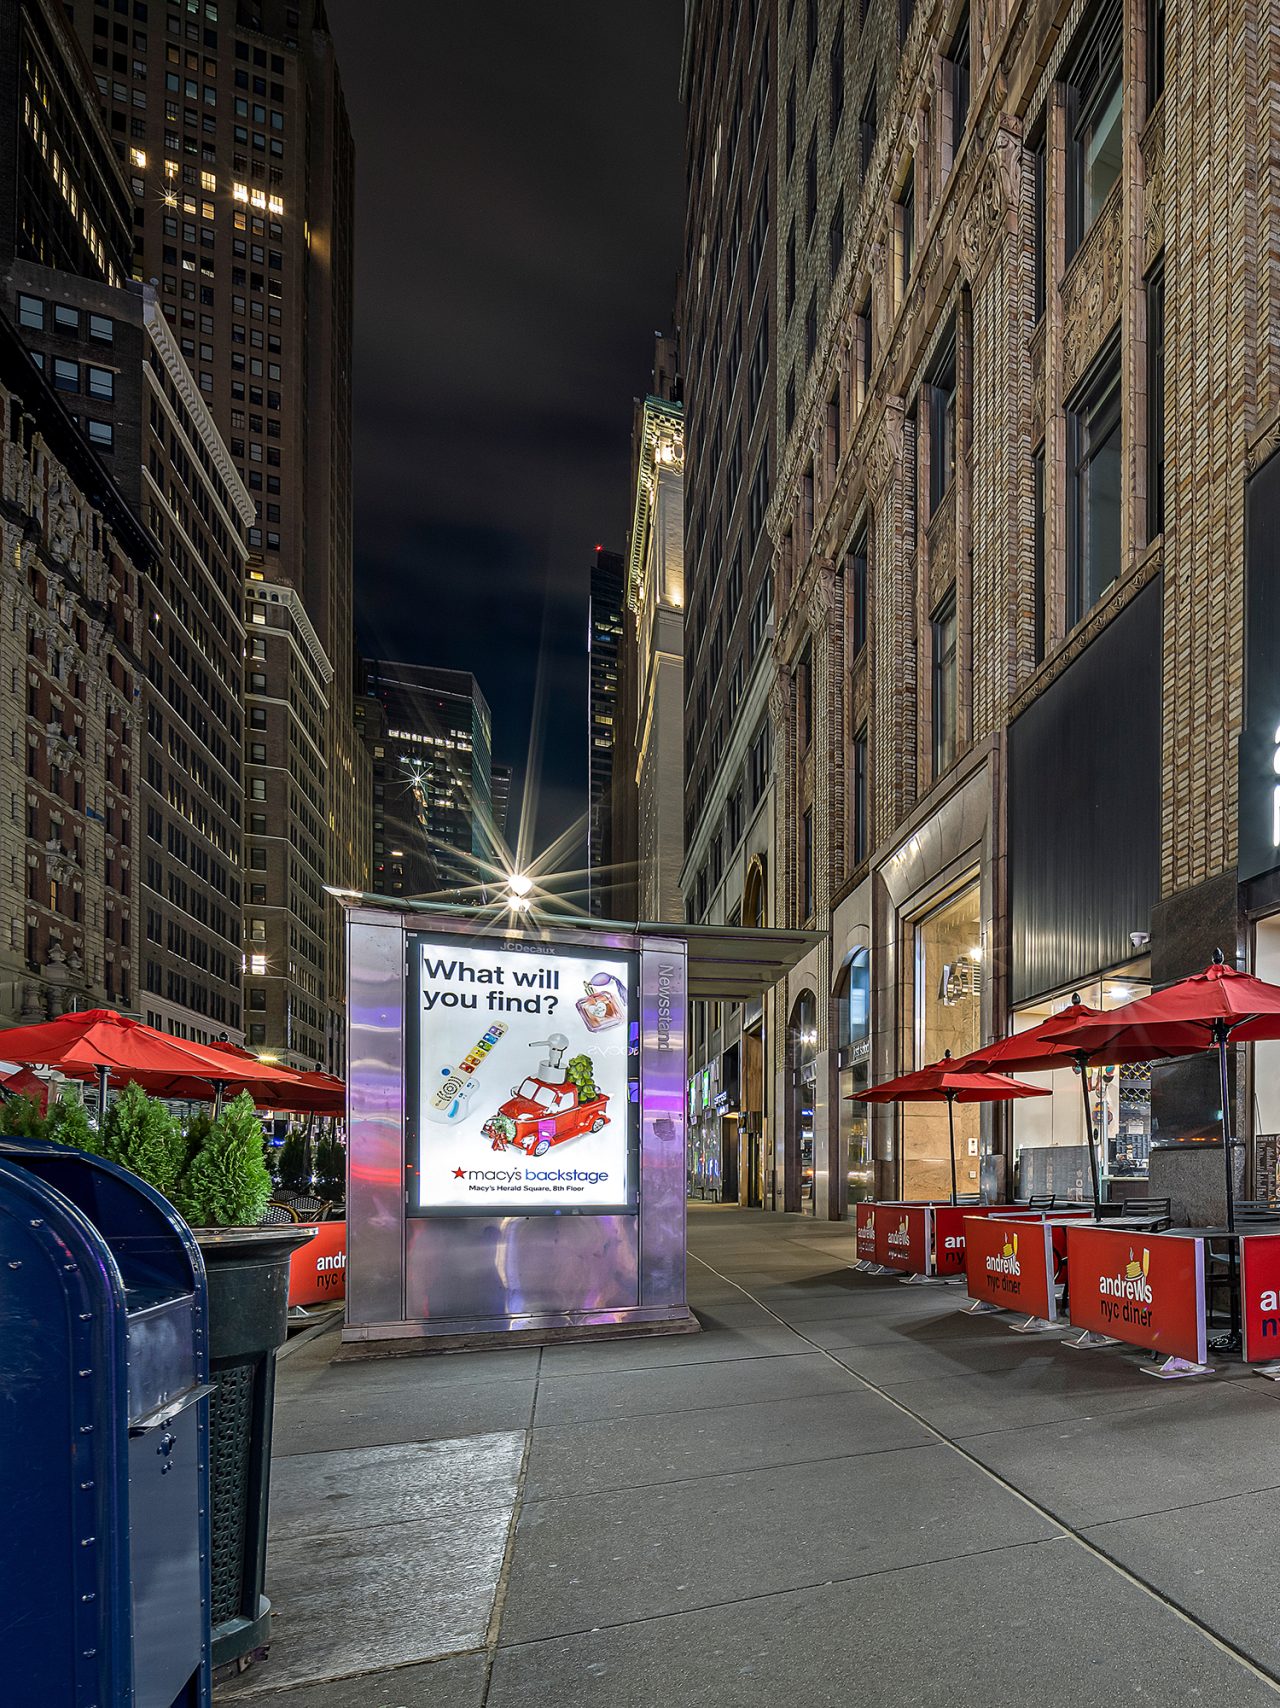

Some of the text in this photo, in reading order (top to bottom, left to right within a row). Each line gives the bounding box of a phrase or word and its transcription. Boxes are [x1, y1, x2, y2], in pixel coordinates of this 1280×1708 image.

[500, 941, 556, 955] JCDecaux
[424, 958, 559, 990] What will
[423, 990, 559, 1015] you find?
[658, 964, 674, 1052] Newsstand
[525, 1168, 609, 1185] backstage
[316, 1251, 346, 1271] andr
[986, 1253, 1020, 1276] andrews
[317, 1273, 338, 1290] nyc
[1099, 1274, 1153, 1304] andrews
[1101, 1300, 1152, 1327] nyc diner
